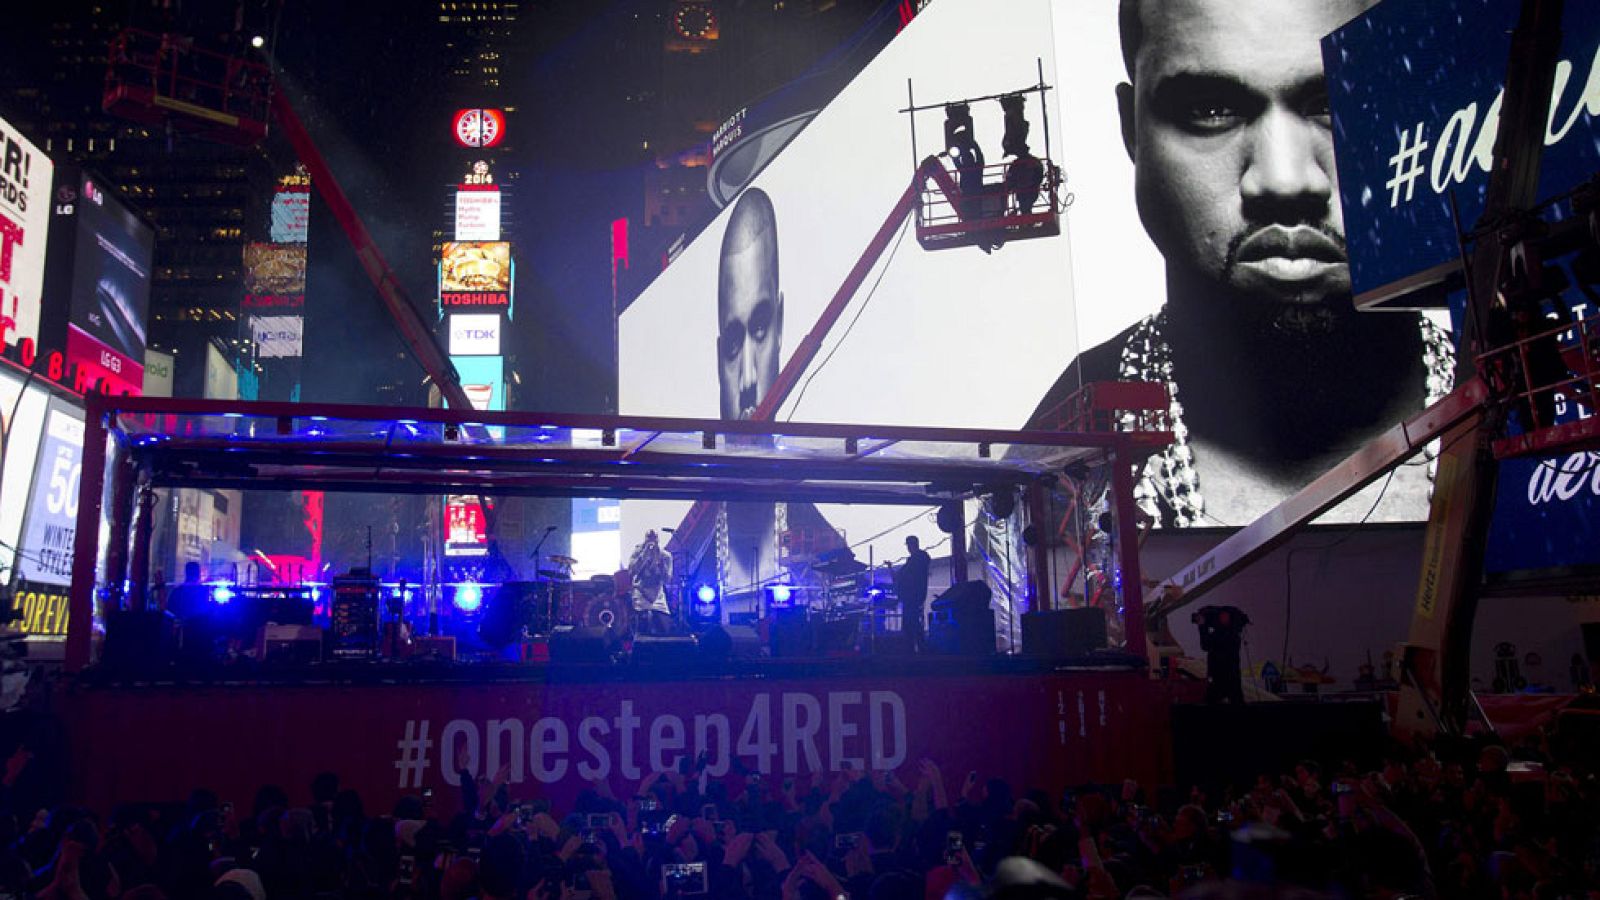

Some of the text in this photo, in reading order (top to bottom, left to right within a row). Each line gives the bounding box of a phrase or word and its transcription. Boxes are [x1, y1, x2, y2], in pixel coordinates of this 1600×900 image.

[713, 107, 747, 143] MARRIOTT
[464, 174, 493, 184] 2014
[56, 204, 74, 215] LG
[442, 293, 509, 305] TOSHIBA
[464, 329, 496, 340] TDK
[395, 690, 908, 795] #onestep4RED
